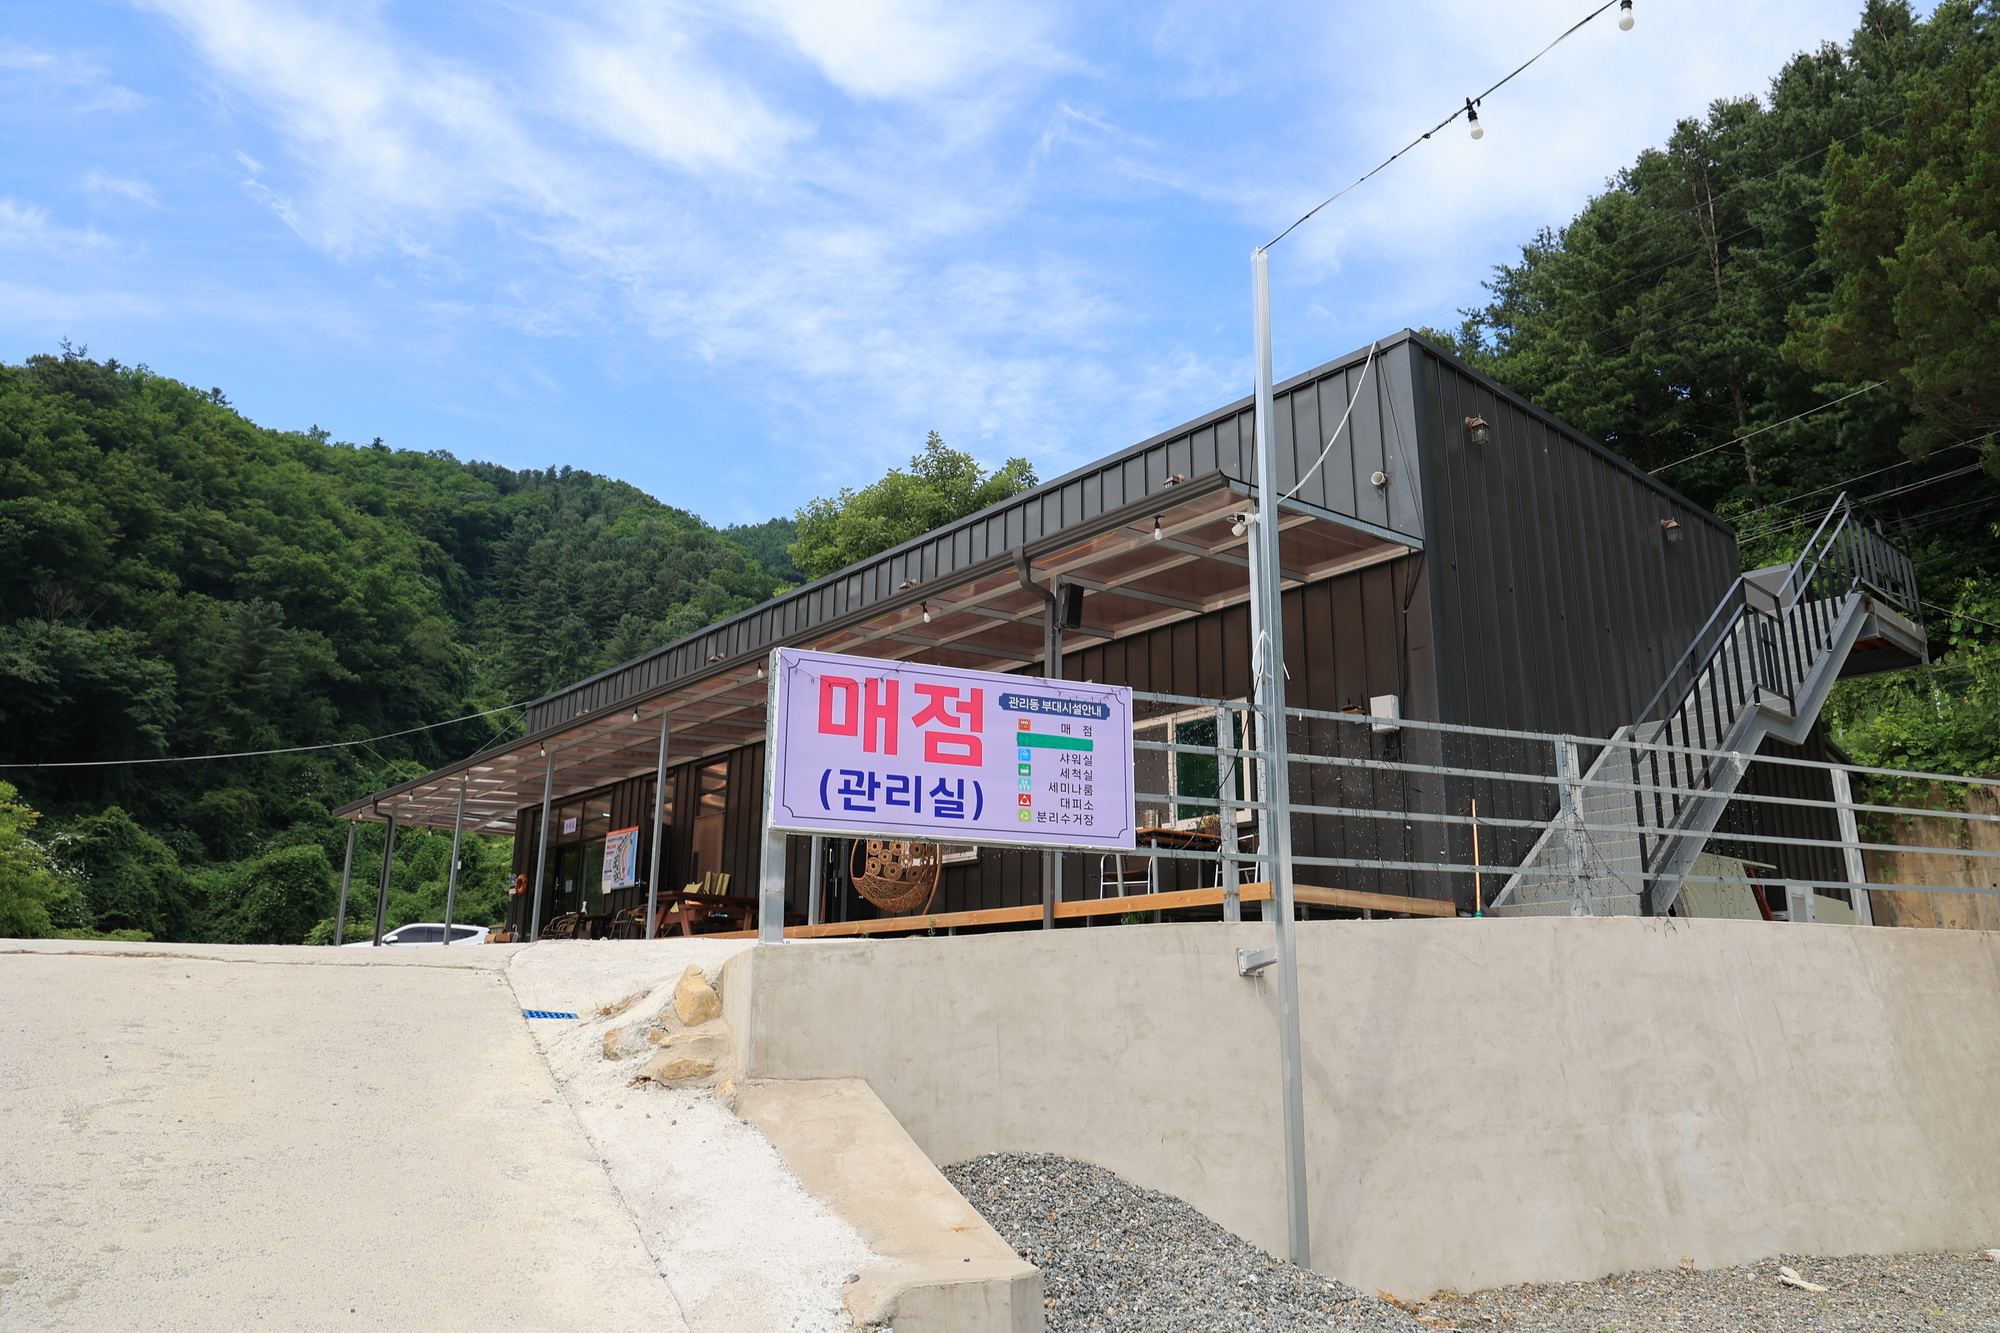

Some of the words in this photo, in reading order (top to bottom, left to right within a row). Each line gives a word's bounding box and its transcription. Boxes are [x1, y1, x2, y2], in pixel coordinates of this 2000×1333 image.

[1008, 696, 1040, 711] 관리동
[1041, 701, 1102, 717] 부대시설안내
[818, 674, 984, 767] 매점
[1059, 753, 1093, 767] 샤워실
[1059, 768, 1093, 781] 세척실
[819, 769, 983, 821] (관리실)
[1048, 782, 1093, 796] 세미나룸
[1060, 798, 1094, 811] 대피소
[1036, 811, 1094, 826] 분리수거장
